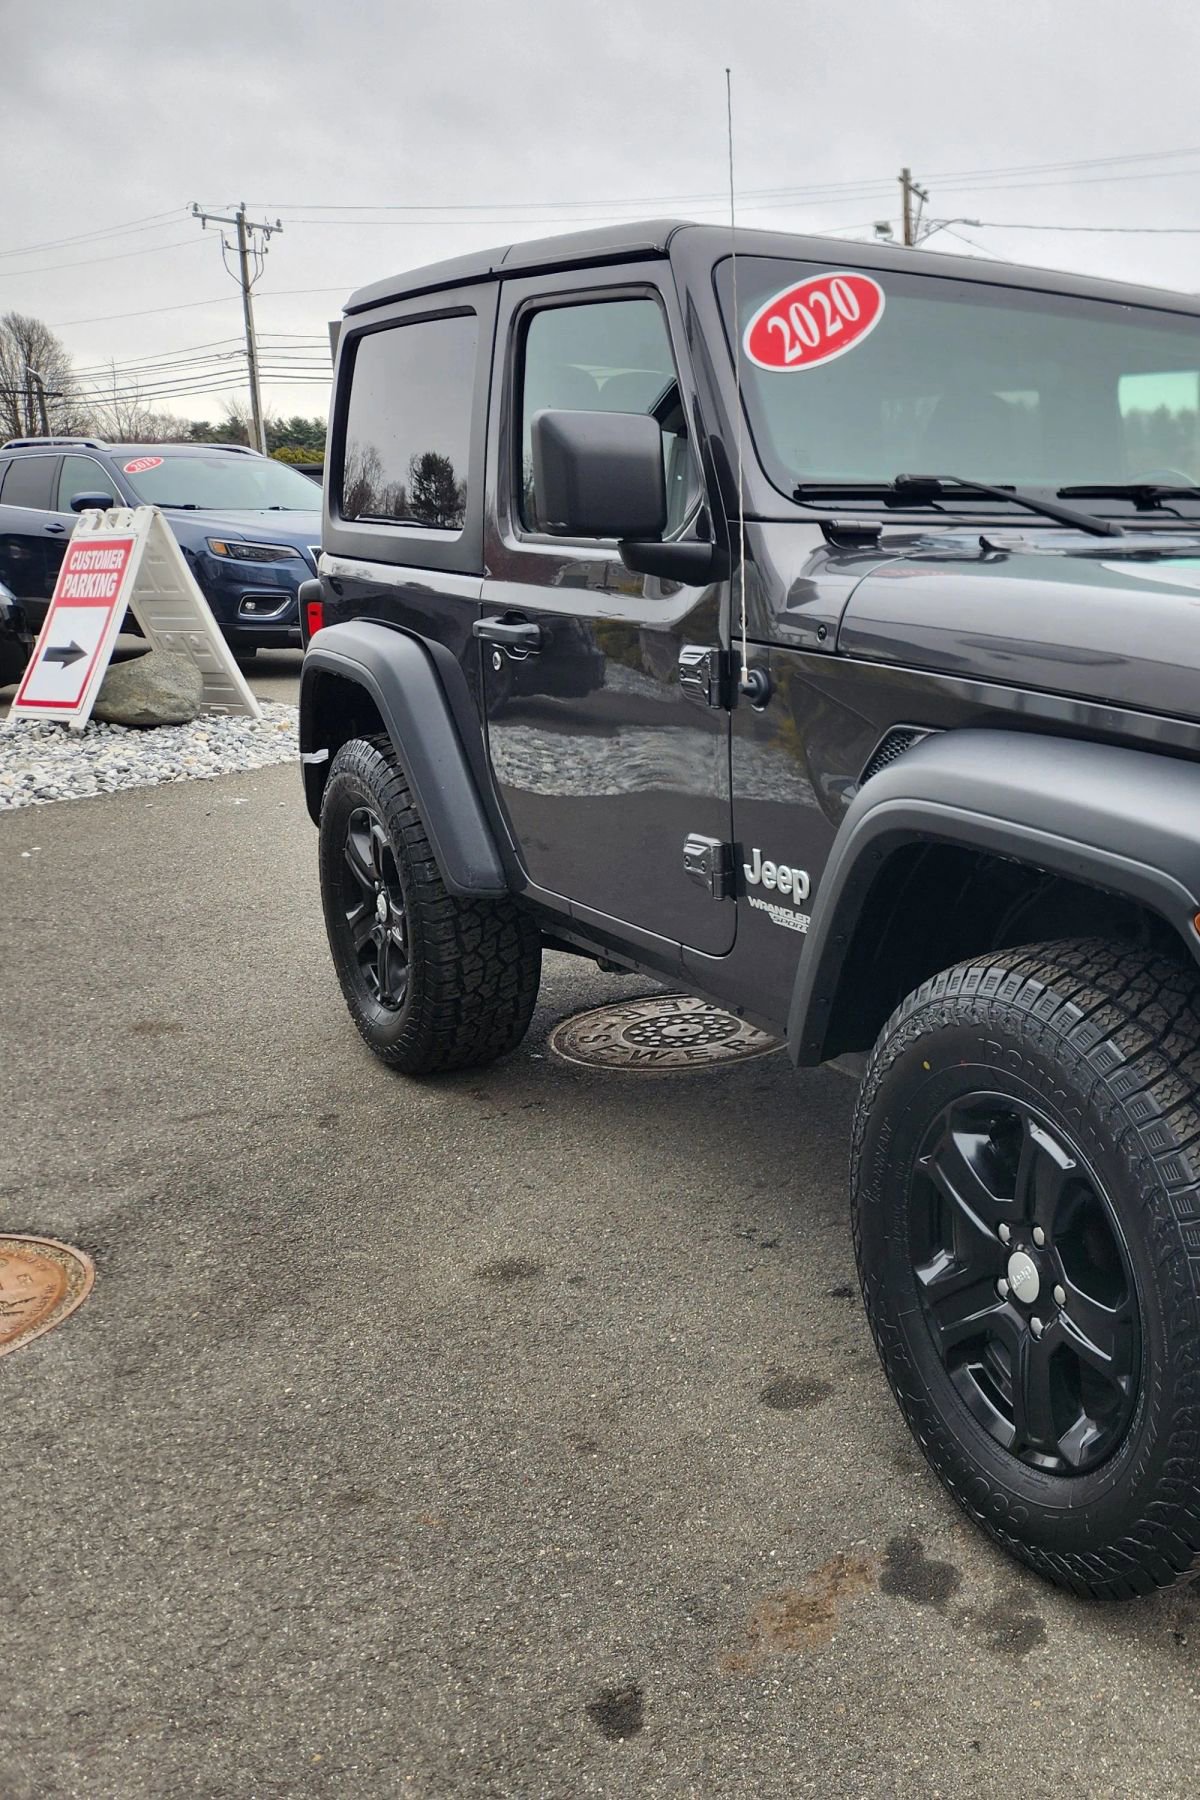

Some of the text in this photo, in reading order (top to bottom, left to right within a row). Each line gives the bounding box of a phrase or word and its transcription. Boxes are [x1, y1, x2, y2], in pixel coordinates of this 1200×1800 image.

[767, 278, 861, 364] 2020
[130, 457, 157, 471] 2019
[70, 550, 123, 570] CUSTOMER
[60, 573, 117, 599] PARKING
[743, 848, 811, 906] Jeep
[747, 895, 811, 925] WRANGLER
